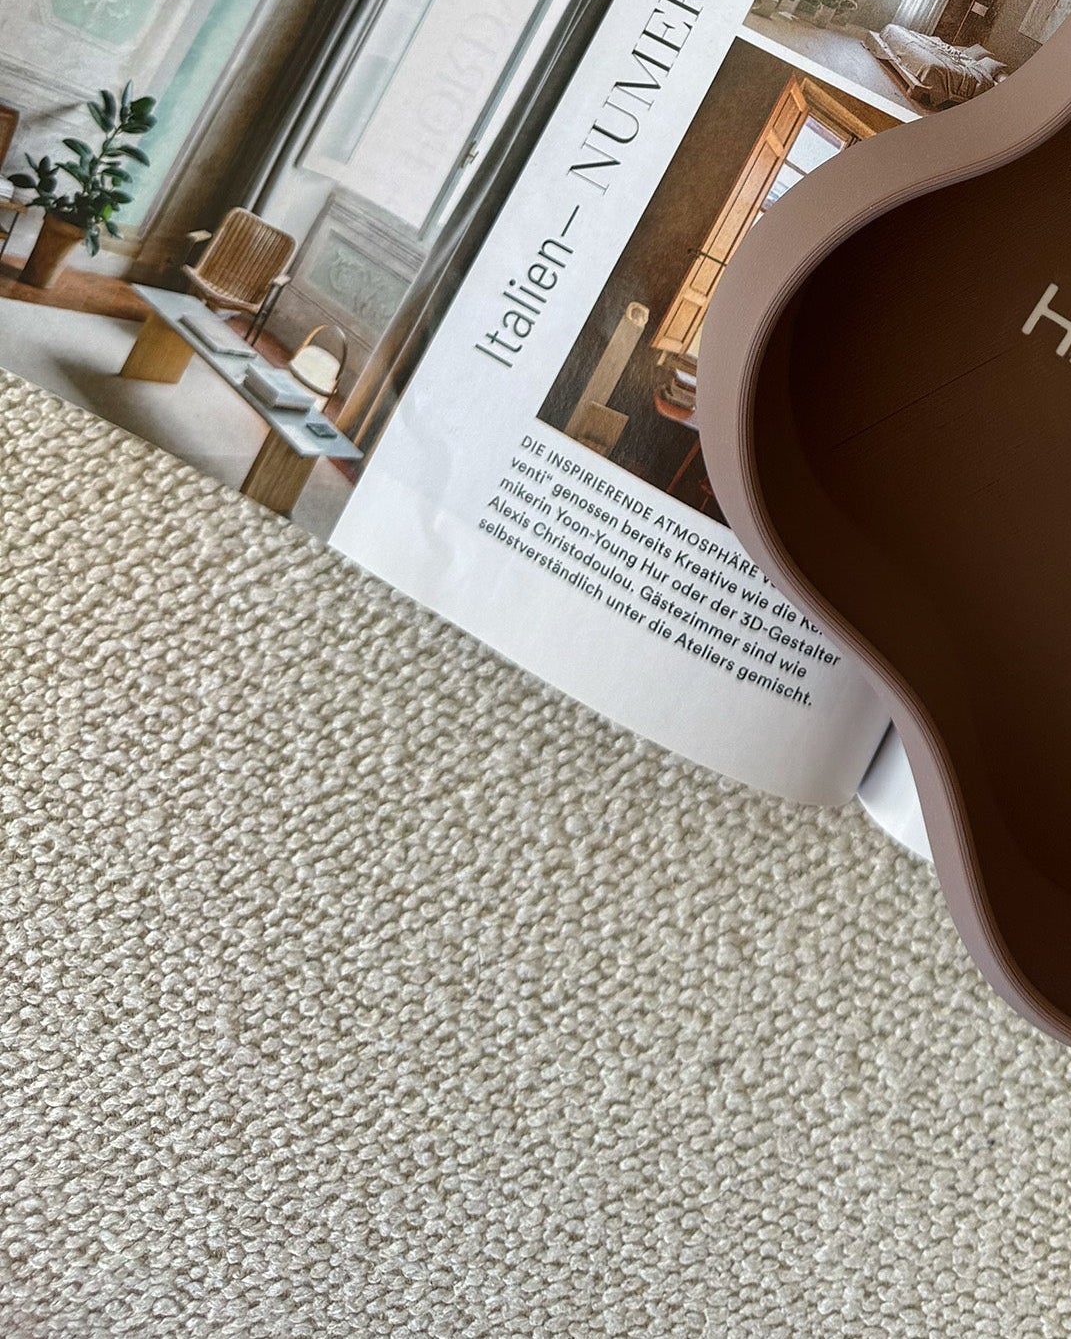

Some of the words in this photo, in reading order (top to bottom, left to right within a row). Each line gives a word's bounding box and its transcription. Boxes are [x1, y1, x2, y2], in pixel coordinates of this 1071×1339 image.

[486, 495, 531, 529] Alexis
[639, 585, 741, 647] Gästezimmer
[741, 641, 778, 665] sind
[779, 658, 807, 678] wie
[499, 477, 552, 515] mikerin
[555, 506, 638, 569] Yoon-Young
[639, 557, 670, 583] Hur
[671, 579, 709, 605] oder
[709, 598, 738, 620] der
[739, 611, 841, 666] 3D-Gestalter
[520, 434, 546, 457] DIE
[546, 449, 654, 520] INSPIRIERENDE
[654, 513, 759, 578] ATMOSPHÄRE
[551, 483, 619, 528] genossen
[620, 519, 672, 559] bereits
[673, 549, 738, 594] Kreative
[741, 587, 769, 609] wie
[771, 602, 797, 622] die
[478, 518, 603, 601] selbstverständlich
[605, 595, 647, 624] unter
[647, 618, 672, 639] die
[673, 632, 735, 672] Ateliers
[736, 666, 812, 707] gemischt.
